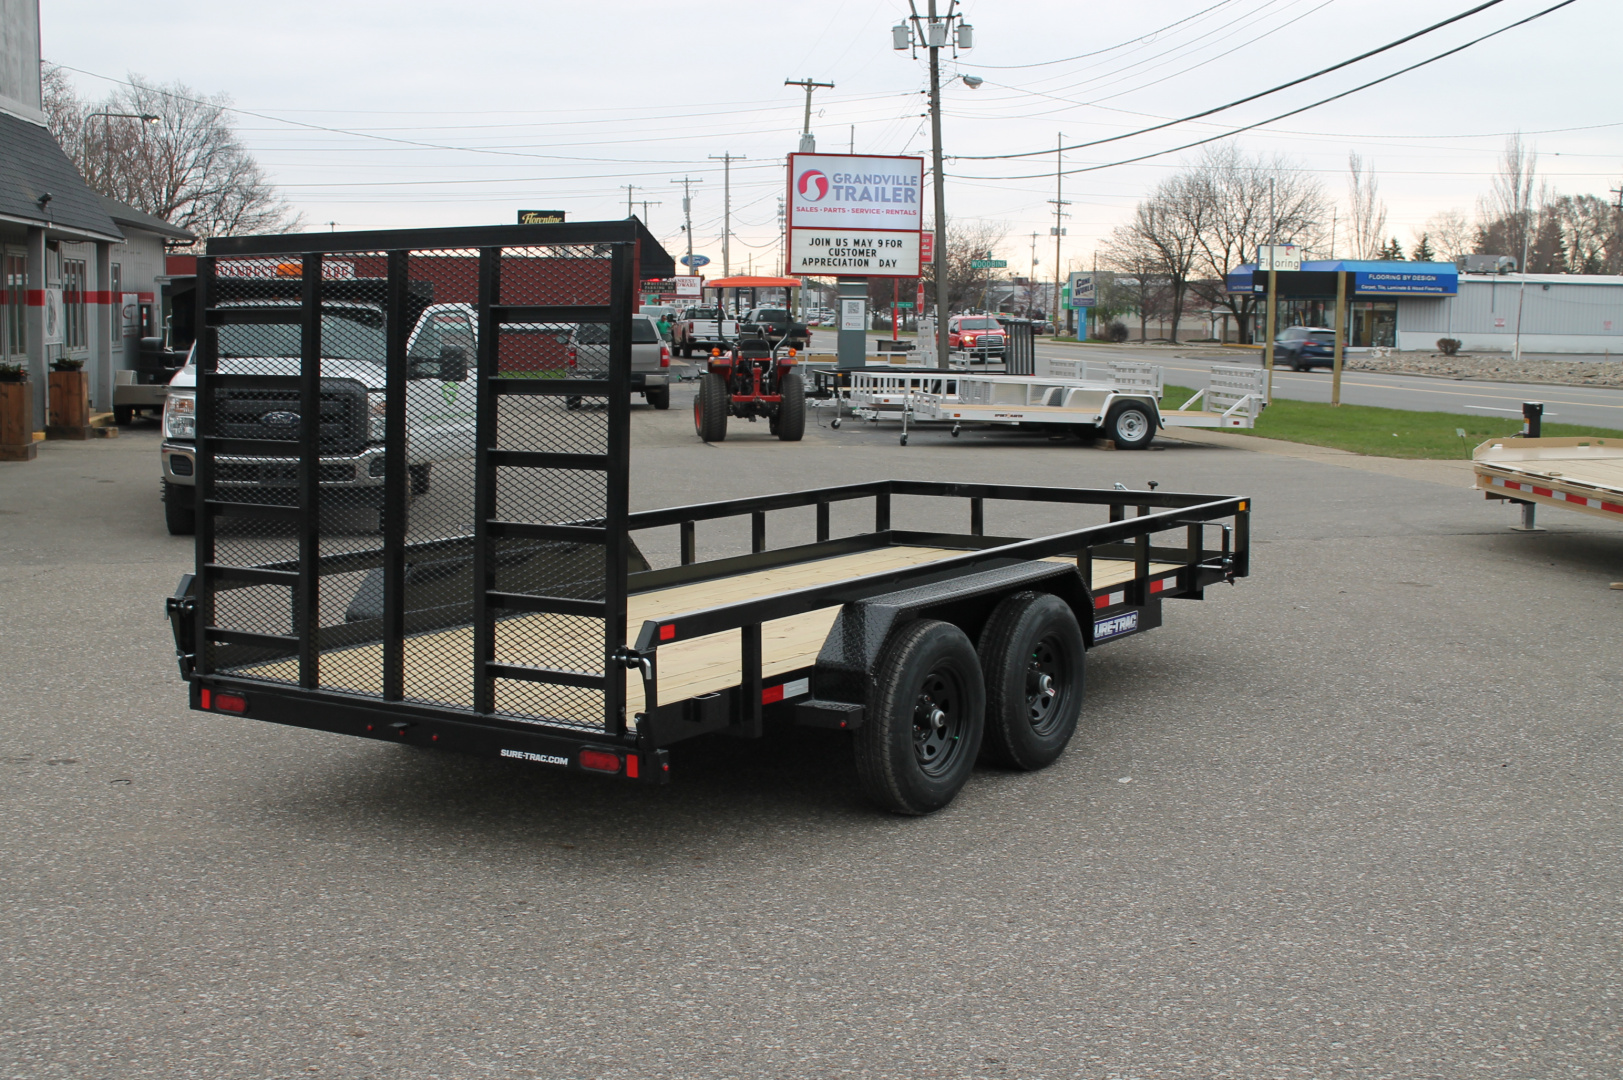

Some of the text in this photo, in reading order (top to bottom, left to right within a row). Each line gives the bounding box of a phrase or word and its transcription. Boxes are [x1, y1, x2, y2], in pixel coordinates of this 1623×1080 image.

[832, 173, 918, 186] GRANDVILLE
[832, 185, 917, 203] TRAILER
[522, 212, 562, 224] Florentine
[809, 238, 902, 248] JOIN US MAY 9 FOR
[828, 248, 877, 257] CUSTOMER
[802, 258, 897, 267] APPRECIATION DAY
[972, 260, 1007, 268] WOODBINE
[1095, 614, 1137, 638] URE-TRAC
[500, 749, 569, 766] SURE-TRAC.COM
